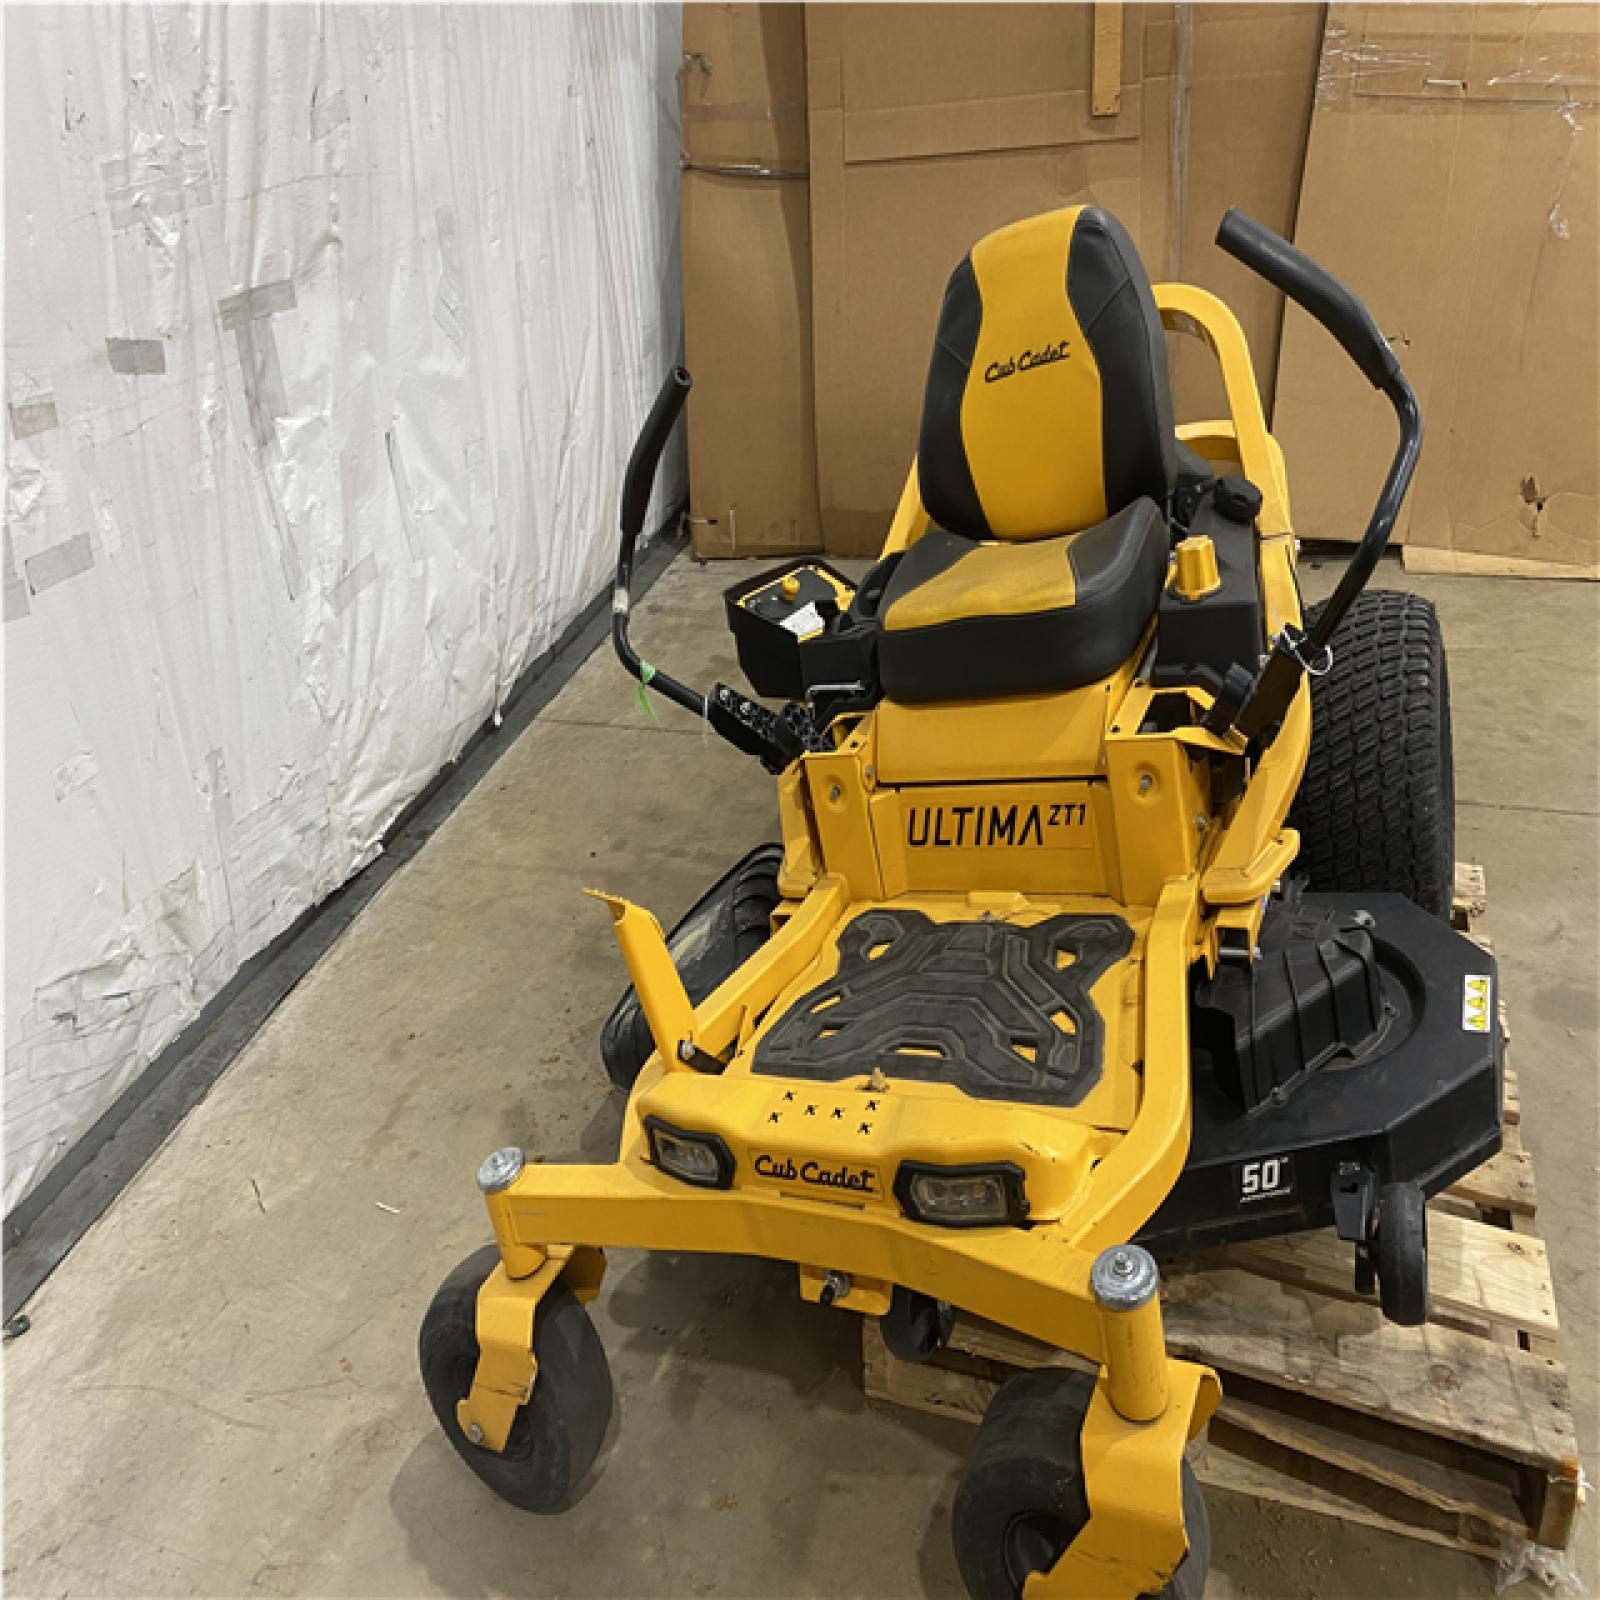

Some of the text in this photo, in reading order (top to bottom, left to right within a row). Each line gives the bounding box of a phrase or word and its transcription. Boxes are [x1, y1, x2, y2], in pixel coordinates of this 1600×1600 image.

[985, 340, 1071, 384] Cub Cadet
[908, 802, 1086, 846] ULTIMA ZT1
[754, 1154, 876, 1193] Cub Cadet
